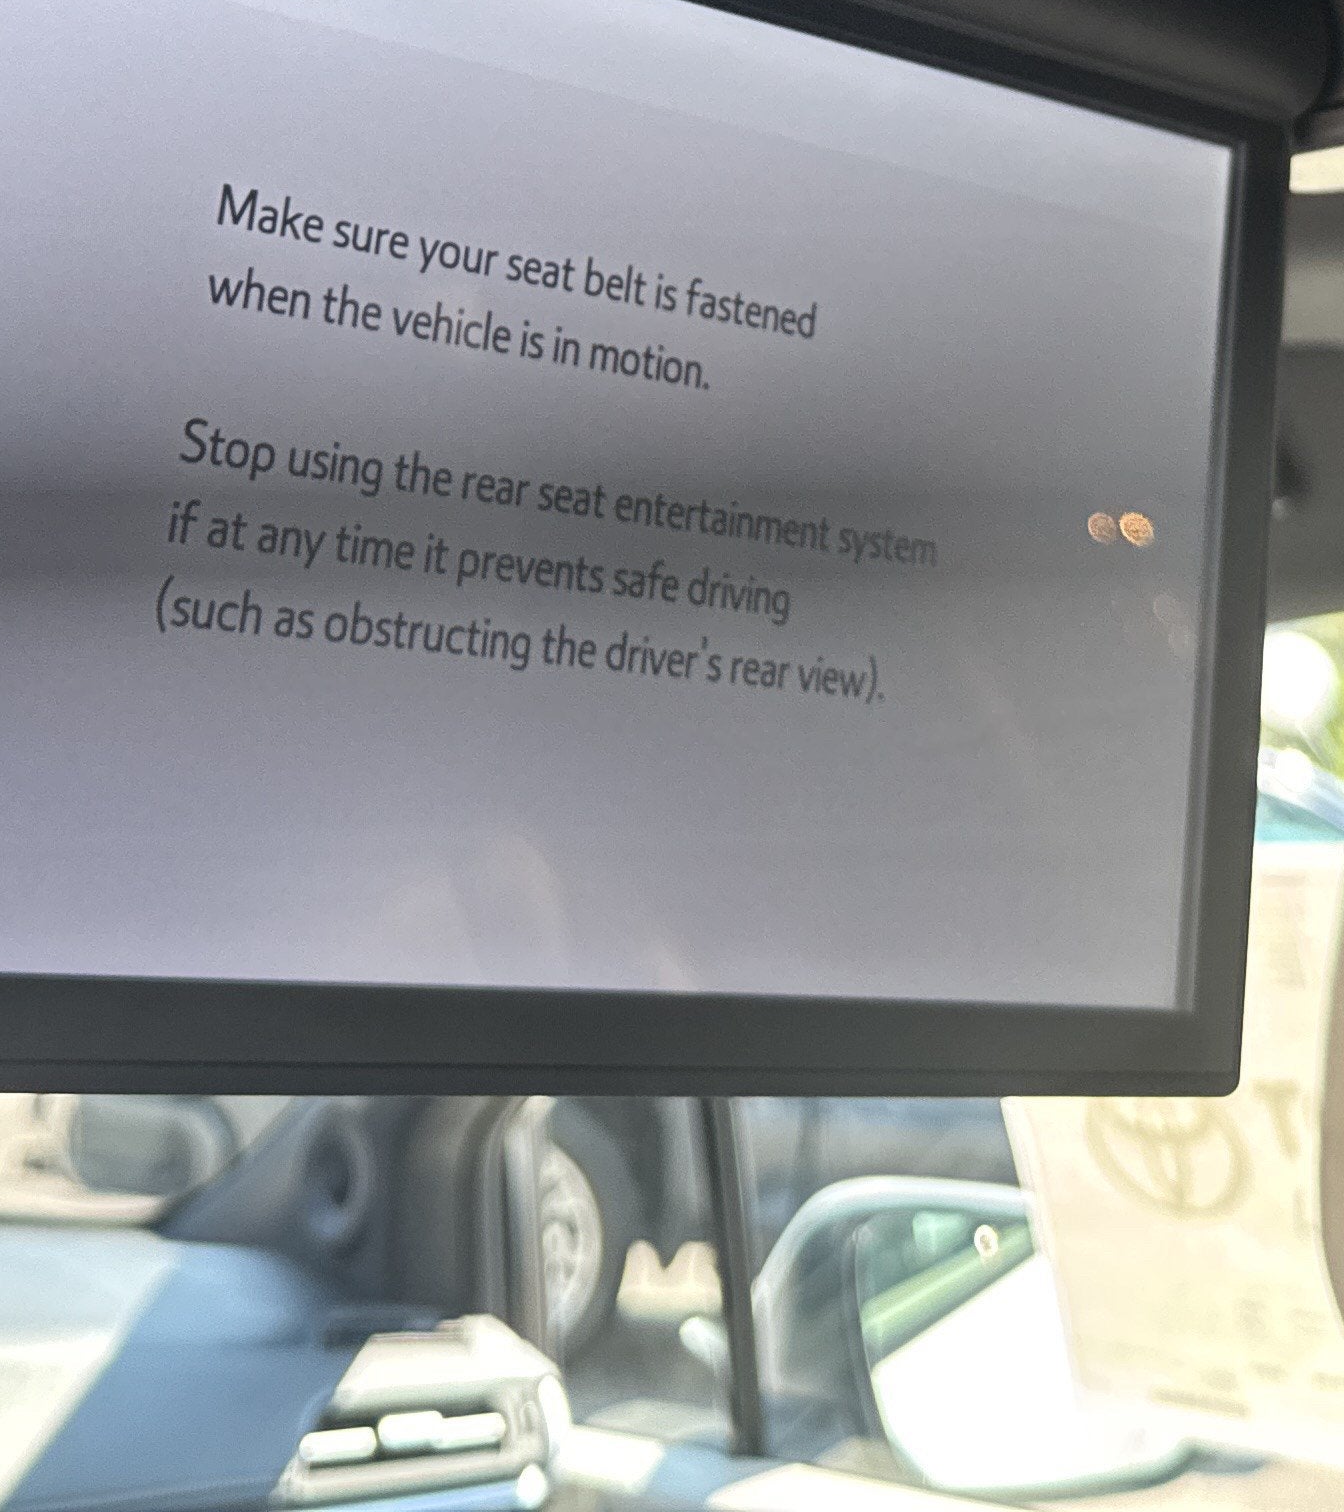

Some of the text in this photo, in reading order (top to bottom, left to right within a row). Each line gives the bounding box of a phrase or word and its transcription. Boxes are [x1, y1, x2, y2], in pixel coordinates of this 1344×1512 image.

[216, 182, 819, 340] Make sure your seat belt is fastened
[207, 265, 711, 391] when the vehicle is in motion.
[178, 416, 937, 567] Stop using the rear seat entertainment system
[167, 498, 791, 627] if at any time it prevents safe driving
[155, 573, 885, 705] (such as obstructing the driver's rear view).
